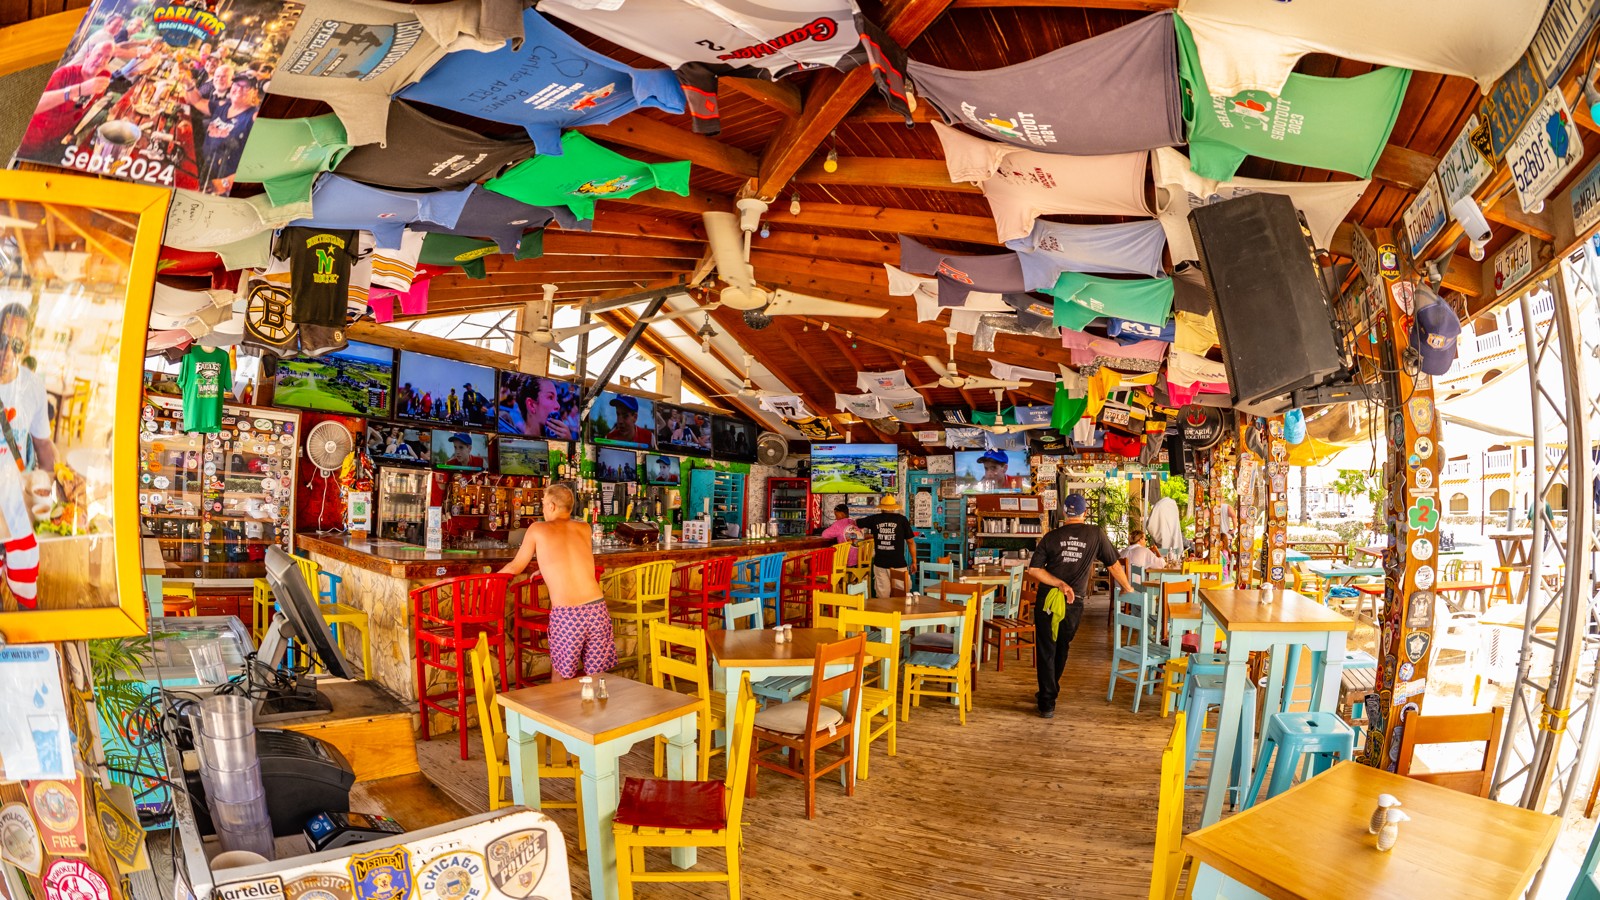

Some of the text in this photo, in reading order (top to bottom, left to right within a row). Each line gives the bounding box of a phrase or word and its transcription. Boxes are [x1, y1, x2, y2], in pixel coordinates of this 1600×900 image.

[154, 6, 225, 35] CARLITOS
[290, 20, 339, 74] STEEL CRAZY
[717, 17, 838, 60] Gamblers
[1270, 97, 1292, 141] SHOOTOUT
[1287, 113, 1305, 135] 2023
[1492, 71, 1532, 144] 31316
[1518, 104, 1550, 149] KENTUCKY
[61, 145, 173, 185] Sept 2024
[1513, 147, 1545, 192] 5260
[316, 249, 335, 274] N
[263, 293, 286, 331] B
[195, 362, 221, 374] EAGLES
[775, 406, 796, 416] 77
[1418, 505, 1429, 522] 2
[11, 651, 31, 659] WATER
[52, 836, 78, 848] FIRE
[120, 827, 140, 861] POLICE
[51, 866, 76, 883] HOBOKEN
[357, 853, 404, 879] MERIDEN
[424, 856, 479, 890] CHICAGO
[500, 839, 541, 884] POLICE
